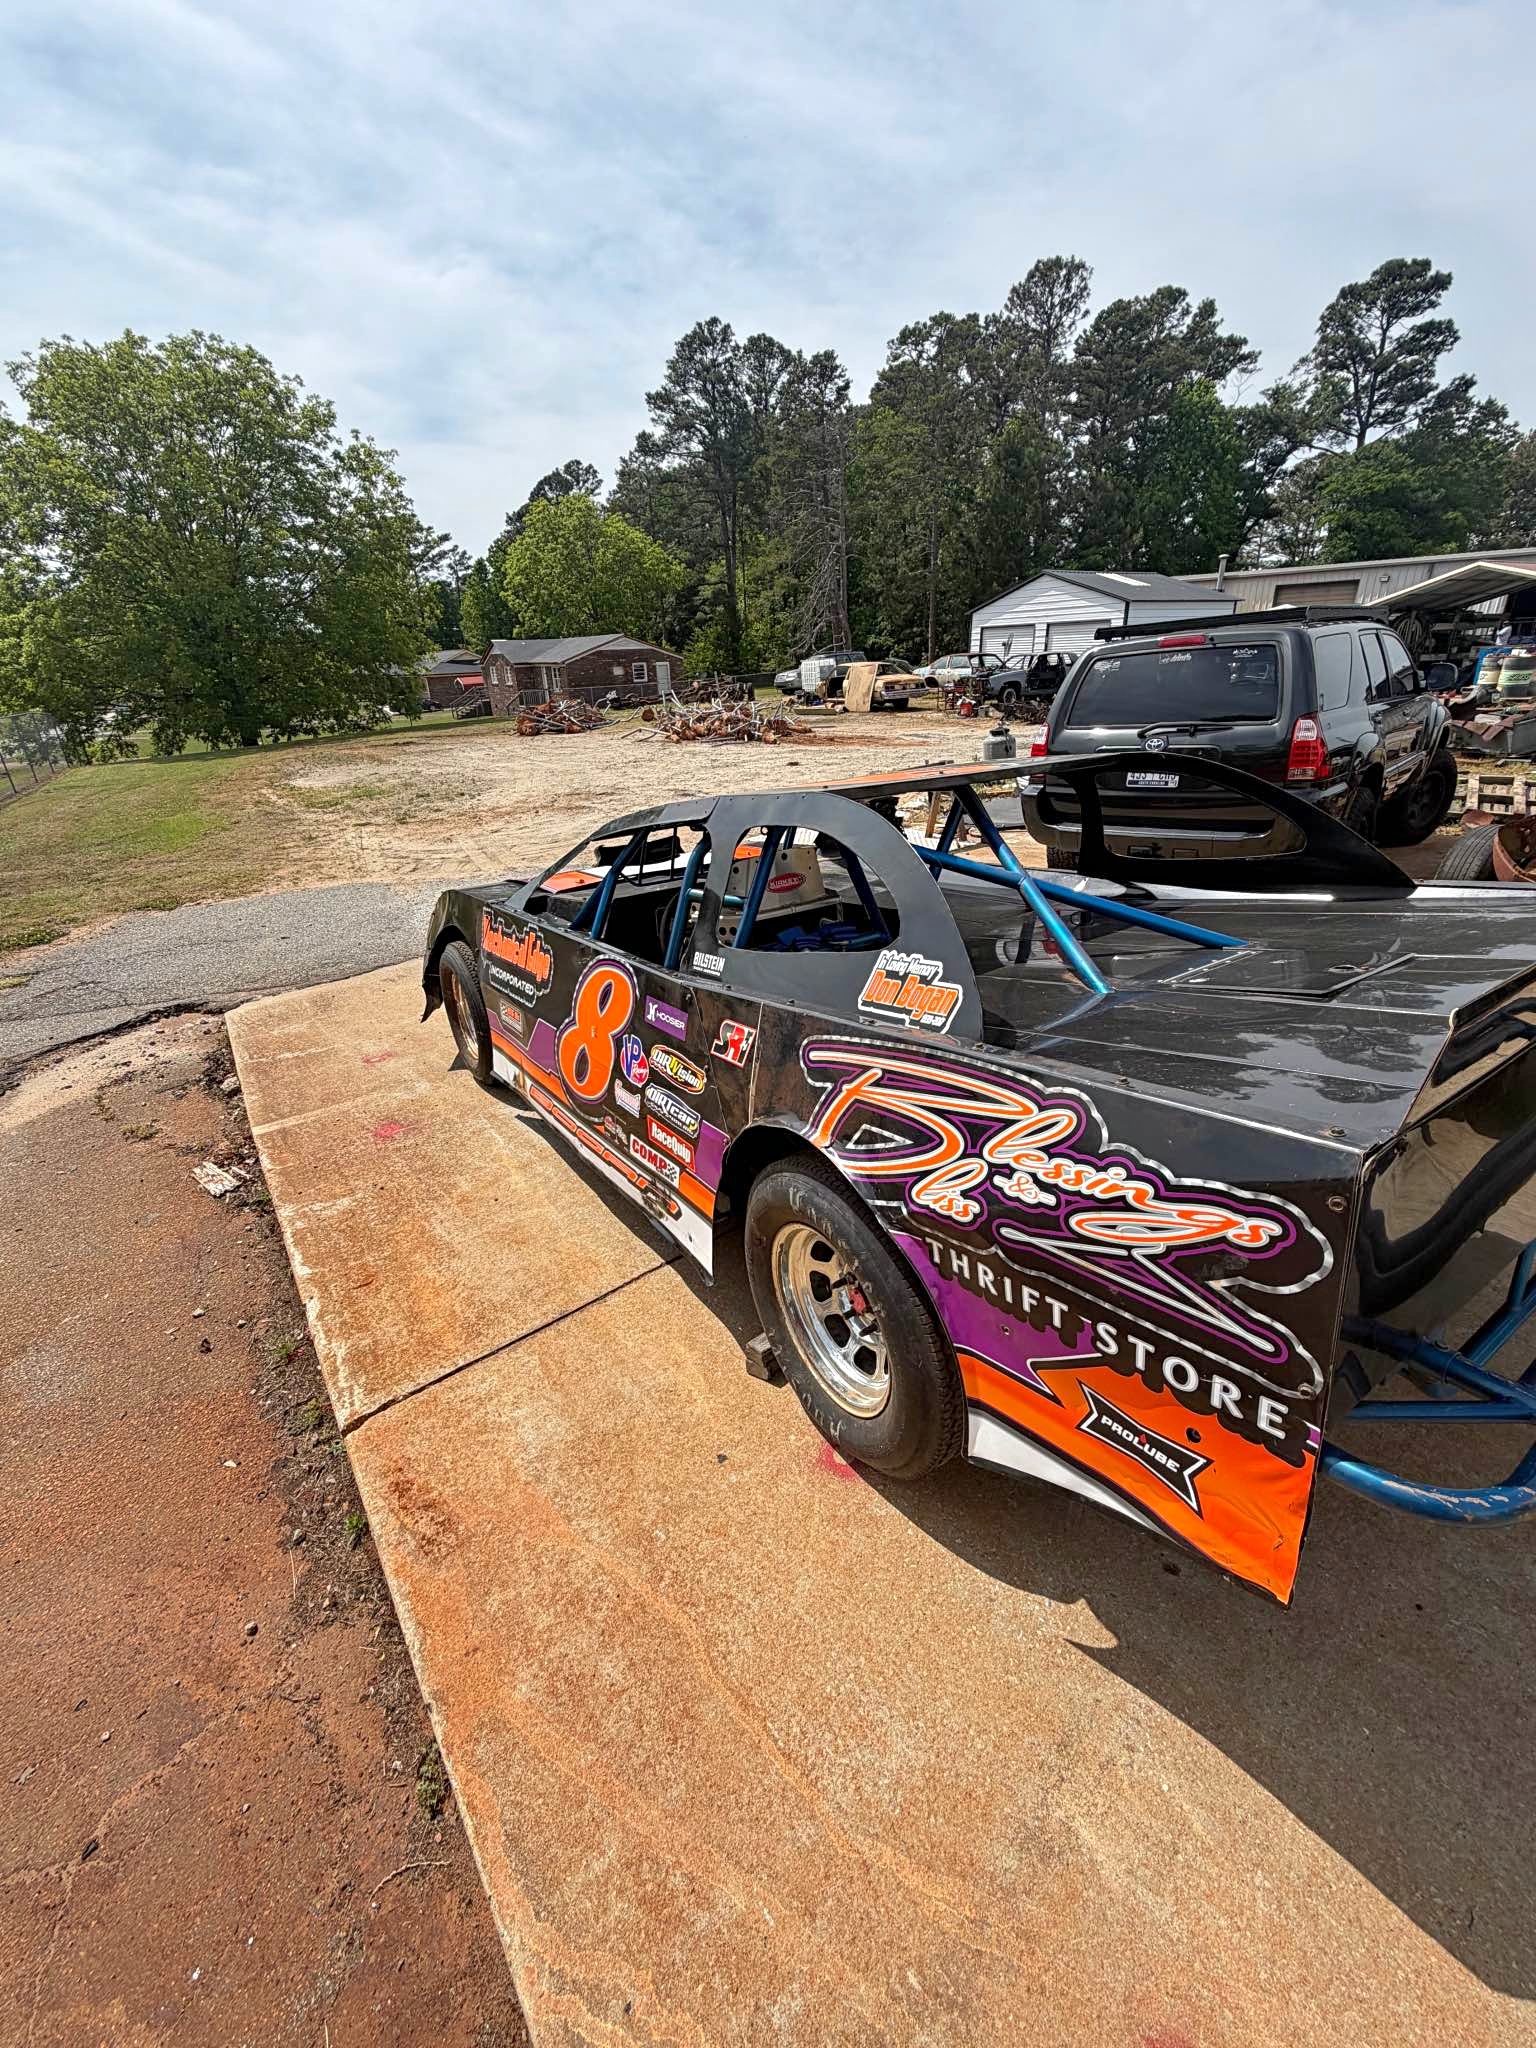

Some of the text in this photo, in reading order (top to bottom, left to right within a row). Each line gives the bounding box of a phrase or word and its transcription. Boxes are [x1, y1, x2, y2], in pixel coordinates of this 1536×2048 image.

[481, 914, 551, 982] Mechanical Edge
[692, 951, 726, 973] BILSTEIN
[885, 956, 909, 976] Loving
[906, 957, 939, 980] Memory
[490, 964, 535, 996] INCORPORATED
[894, 974, 959, 1020] Bogan
[558, 964, 637, 1102] 8
[656, 1010, 686, 1031] HOOSIER
[622, 1034, 642, 1080] VP
[631, 1139, 668, 1171] COMP
[651, 1121, 691, 1166] RaceQuip
[926, 1236, 1289, 1439] THRIFT STORE
[1101, 1414, 1180, 1473] PROLUBE
